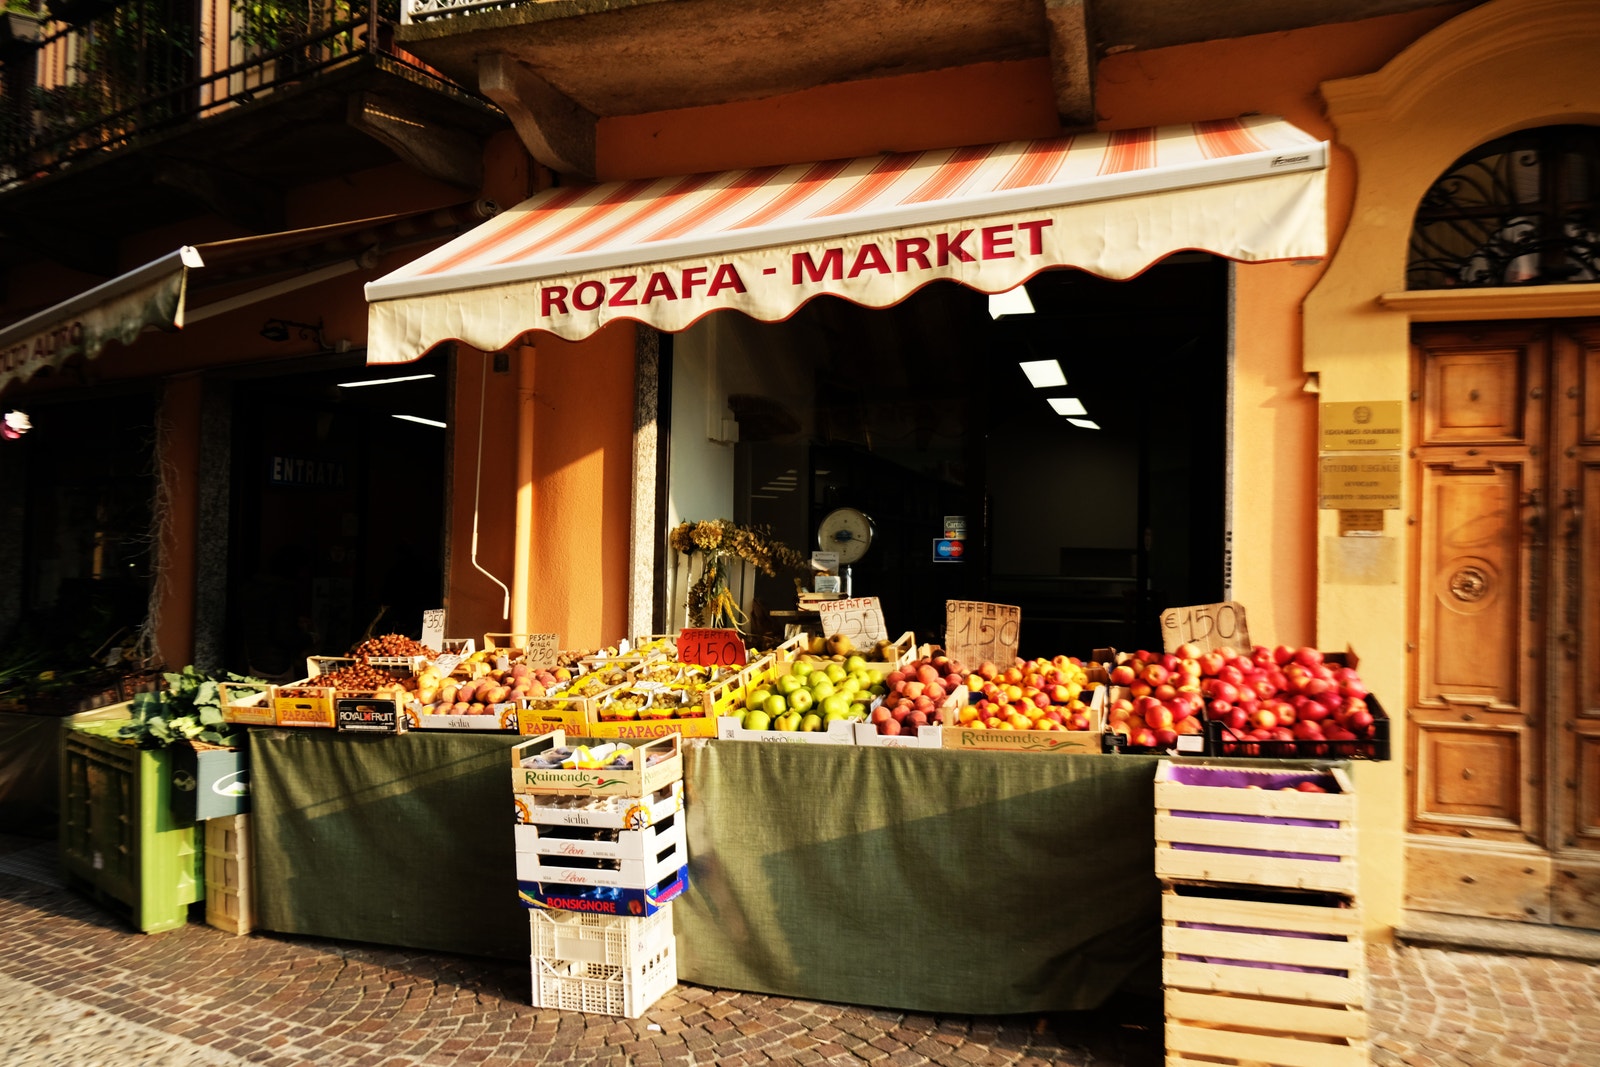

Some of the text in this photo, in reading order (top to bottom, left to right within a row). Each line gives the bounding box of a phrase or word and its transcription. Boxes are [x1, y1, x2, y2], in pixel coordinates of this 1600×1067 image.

[541, 262, 747, 317] ROZAFA
[791, 218, 1054, 285] MARKET
[273, 456, 344, 487] ENTRATA
[820, 598, 872, 612] OFFERTA
[947, 602, 1018, 616] OFFERTA
[529, 633, 556, 641] PESCHE
[683, 631, 730, 641] OFFERTA
[281, 709, 327, 721] PAPAGNI
[339, 711, 394, 722] ROYAL FRUIT
[448, 718, 470, 728] sicilia
[961, 731, 1040, 746] Raimondo
[525, 770, 591, 785] Raimondo
[563, 813, 590, 825] sicilia
[546, 896, 617, 914] BONSIGNORE
